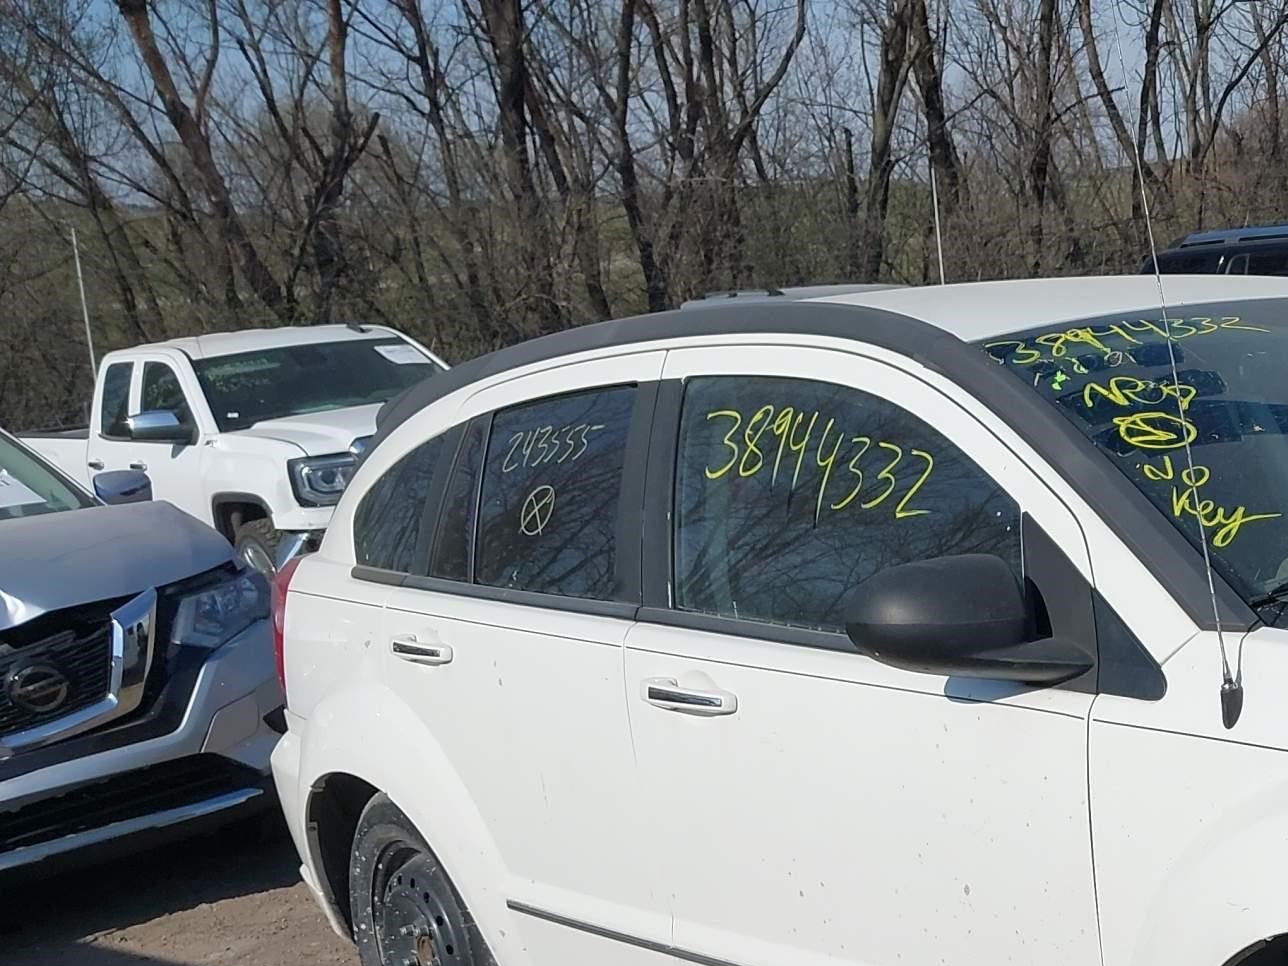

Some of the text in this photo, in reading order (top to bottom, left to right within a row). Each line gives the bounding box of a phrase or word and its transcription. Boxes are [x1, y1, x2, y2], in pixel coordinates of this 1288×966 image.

[984, 317, 1271, 364] 38944332
[502, 424, 606, 472] 243555
[705, 404, 932, 526] 38944332
